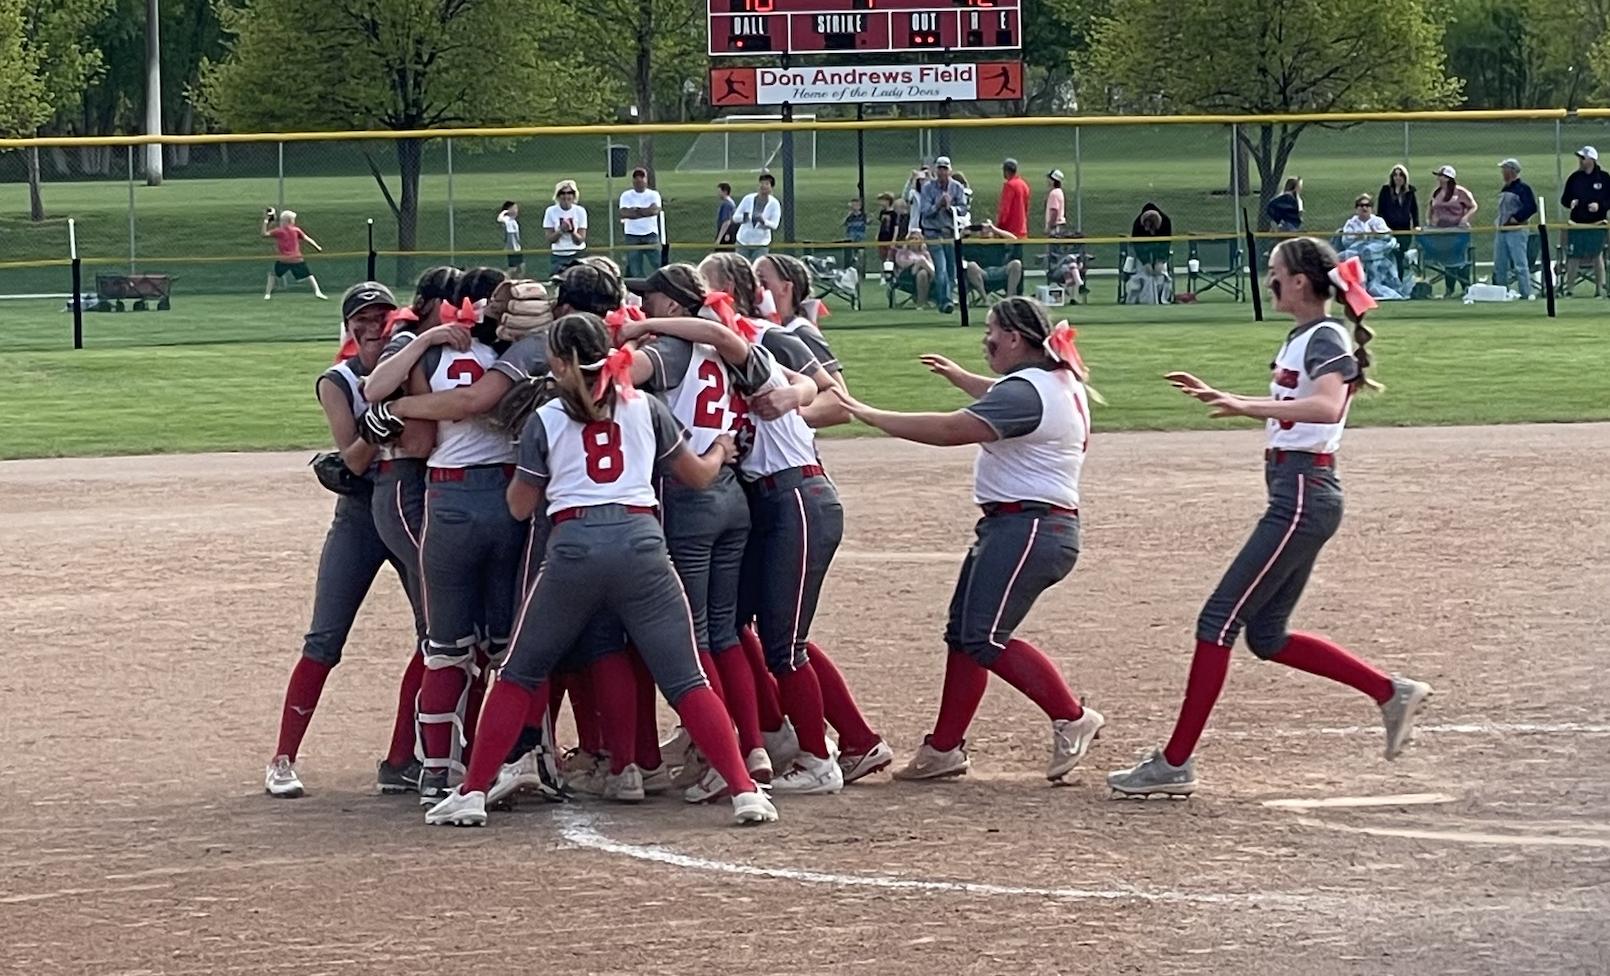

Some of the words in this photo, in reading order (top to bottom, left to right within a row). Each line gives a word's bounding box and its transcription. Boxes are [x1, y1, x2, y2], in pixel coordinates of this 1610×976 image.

[817, 15, 862, 33] STRIKE
[911, 13, 936, 31] OUT
[760, 70, 805, 86] Don
[811, 68, 913, 86] Andrews
[919, 66, 972, 83] Field
[792, 88, 828, 99] Home
[831, 87, 849, 101] of
[849, 87, 868, 98] the
[871, 86, 904, 99] Lady
[907, 85, 940, 97] Dons
[693, 359, 725, 430] 2
[581, 418, 624, 484] 8
